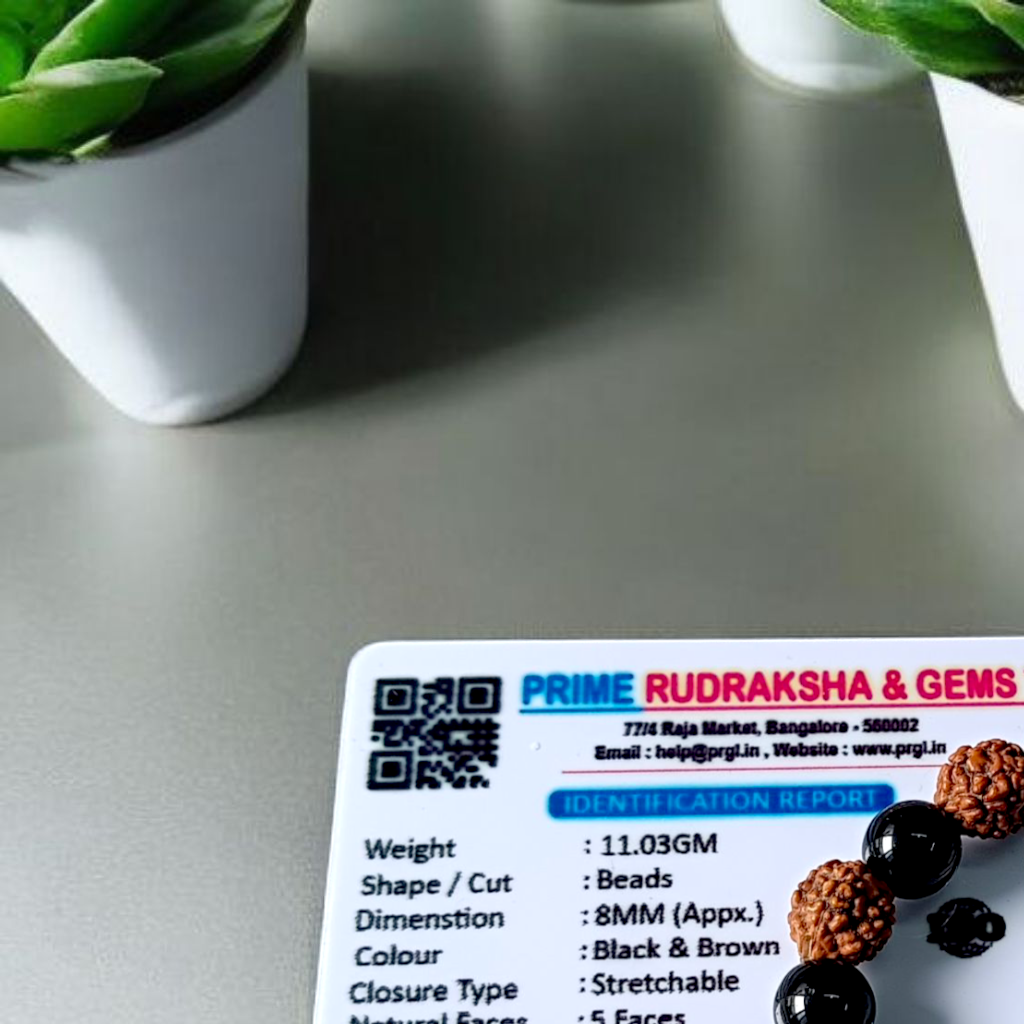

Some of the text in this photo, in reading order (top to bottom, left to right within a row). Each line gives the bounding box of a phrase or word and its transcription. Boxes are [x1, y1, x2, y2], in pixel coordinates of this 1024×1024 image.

[521, 673, 634, 705] PRIME
[645, 669, 873, 705] RUDRAKSHA
[882, 670, 908, 700] &
[916, 668, 1017, 699] GEMS
[661, 721, 698, 739] Raja
[702, 720, 761, 737] Market,
[766, 719, 848, 738] Bangalore
[862, 718, 919, 734] 560002
[594, 744, 641, 761] Email
[655, 744, 760, 763] help@prgl.in
[773, 742, 838, 758] Website
[852, 740, 946, 760] www.prgl.in
[564, 788, 877, 814] IDENTIFICATION REPORT
[364, 837, 456, 863] Weight
[601, 833, 718, 855] 11.03GM
[361, 873, 441, 899] Shape
[447, 871, 462, 897] /
[468, 872, 514, 894] Cut
[596, 868, 673, 890] Beads
[354, 907, 505, 931] Dimenstion
[594, 903, 665, 926] 8MM
[673, 900, 764, 928] (Appx.)
[354, 944, 443, 966] Colour
[592, 937, 661, 960] Black
[669, 938, 690, 957] &
[697, 937, 780, 958] Brown
[349, 980, 448, 1004] Closure
[456, 978, 519, 1005] Type
[591, 969, 740, 995] Stretchable
